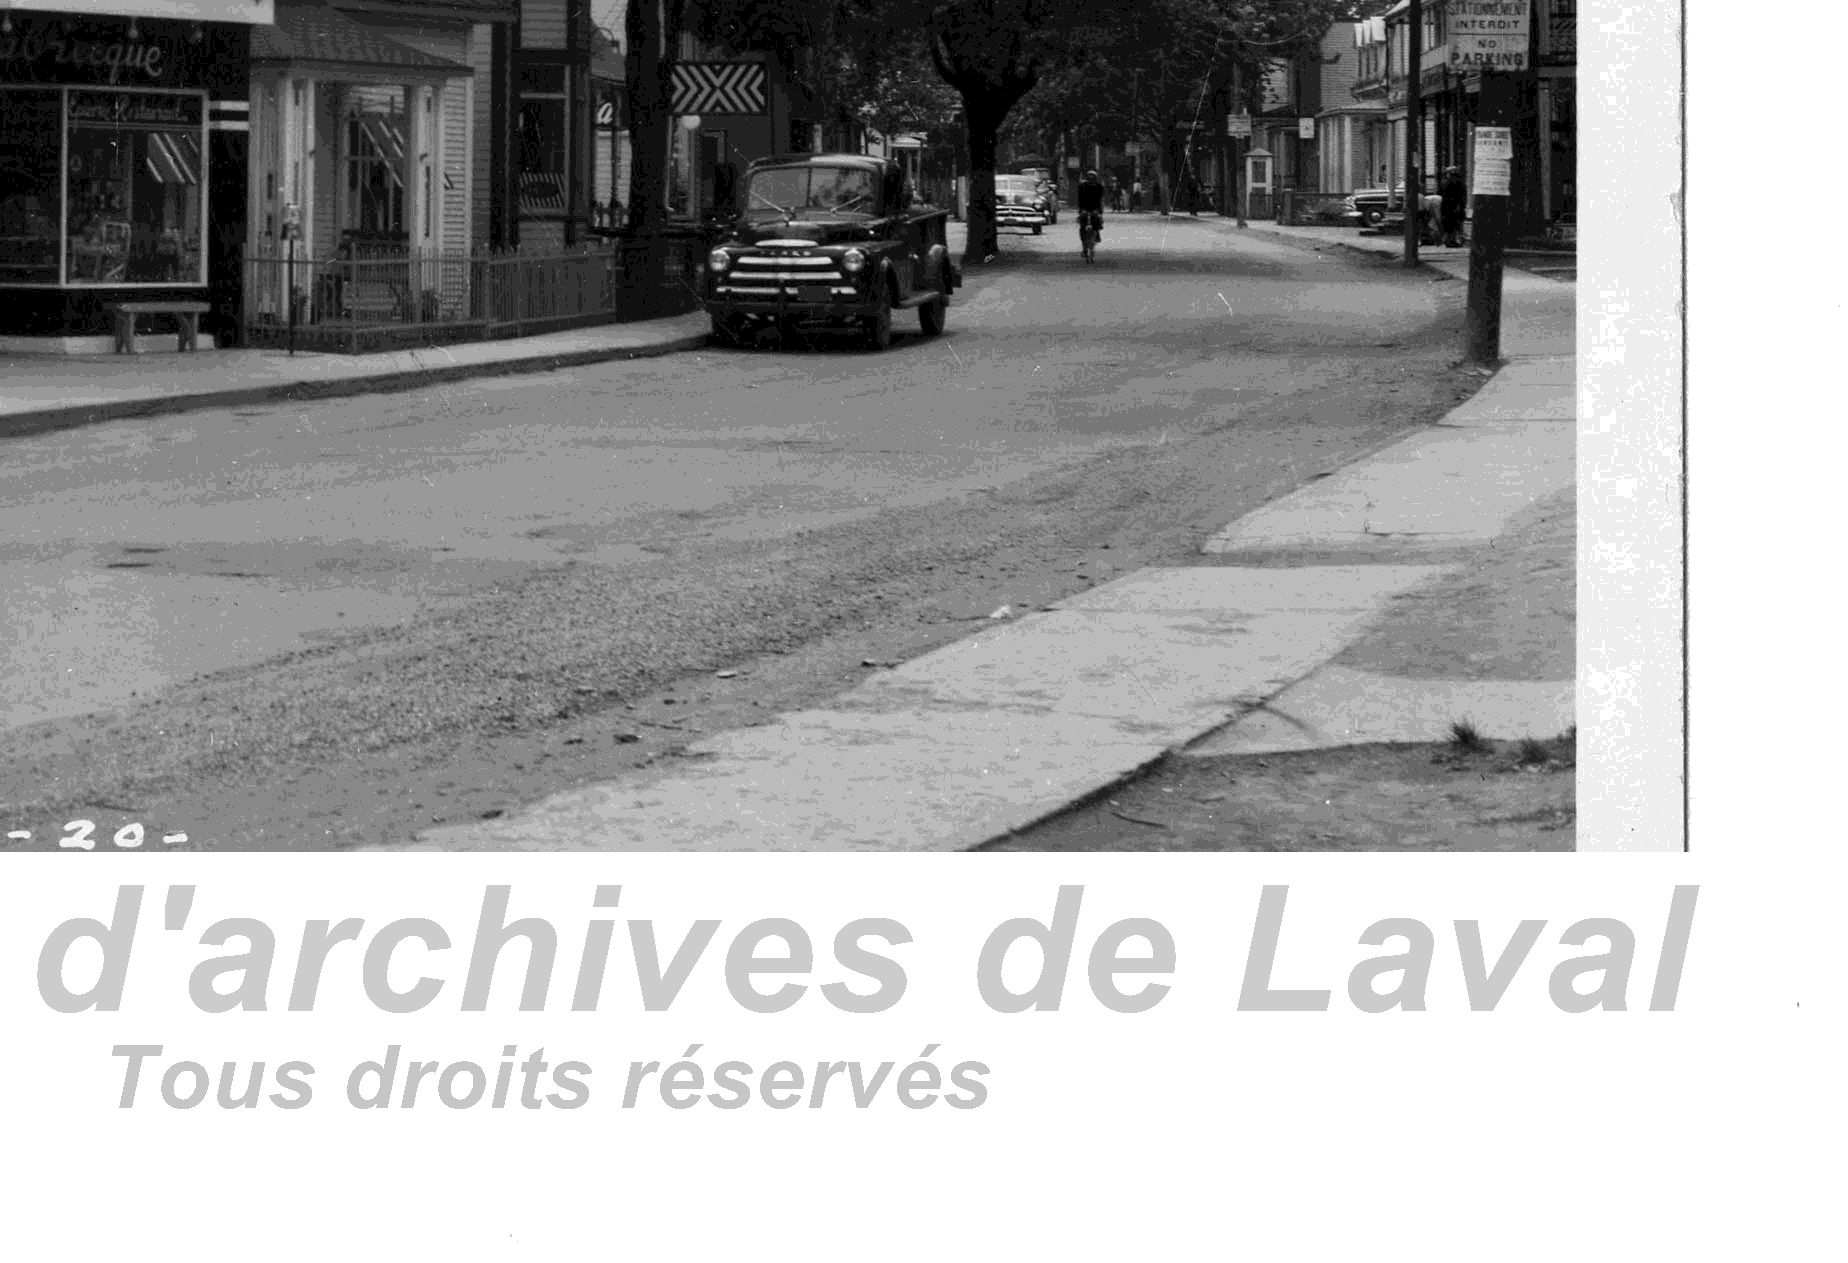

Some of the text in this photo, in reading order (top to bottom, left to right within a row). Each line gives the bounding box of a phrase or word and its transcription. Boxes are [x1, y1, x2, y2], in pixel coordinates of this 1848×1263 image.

[1455, 19, 1520, 30] INTERDIT
[1477, 39, 1497, 48] NO
[1450, 51, 1524, 66] PARKING
